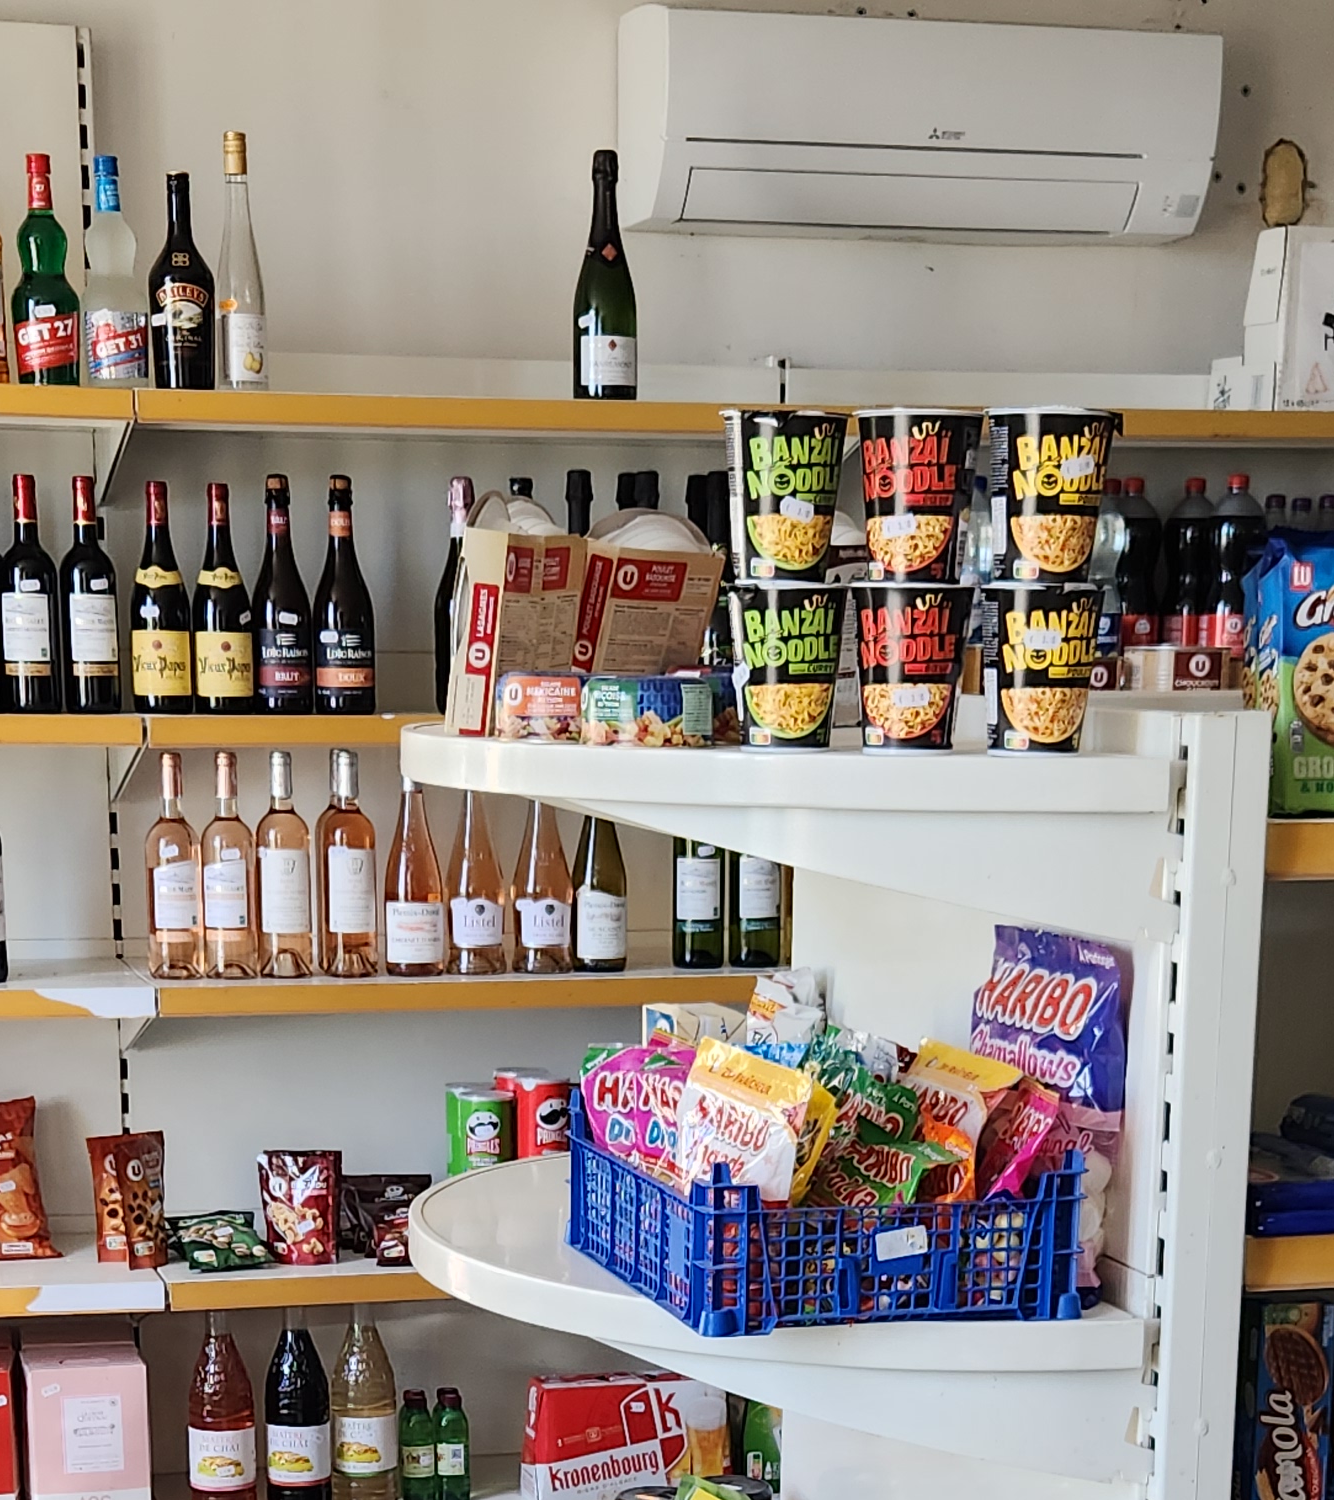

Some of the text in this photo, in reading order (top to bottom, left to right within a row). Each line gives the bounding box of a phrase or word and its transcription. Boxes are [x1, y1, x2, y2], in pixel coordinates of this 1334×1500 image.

[17, 318, 73, 346] GET 27
[95, 335, 143, 356] GET 31
[747, 432, 840, 470] BANZAÏ
[863, 430, 953, 474] BANZAÏ
[746, 462, 839, 501] NOODLE
[863, 464, 957, 502] NOODLE
[1293, 564, 1311, 586] LU
[743, 606, 835, 641] BANZAÏ
[860, 602, 950, 640] BANZAÏ
[743, 635, 838, 671] NOODLE
[860, 635, 956, 670] NOODLE
[1002, 638, 1097, 674] NOODLE
[274, 671, 299, 682] BRUT
[338, 671, 365, 682] DOUX
[463, 912, 496, 929] Listel
[533, 913, 565, 929] Listel
[977, 966, 1095, 1038] HARIBO
[971, 1025, 1079, 1086] Chamallows
[548, 1449, 661, 1492] Kronenbourg
